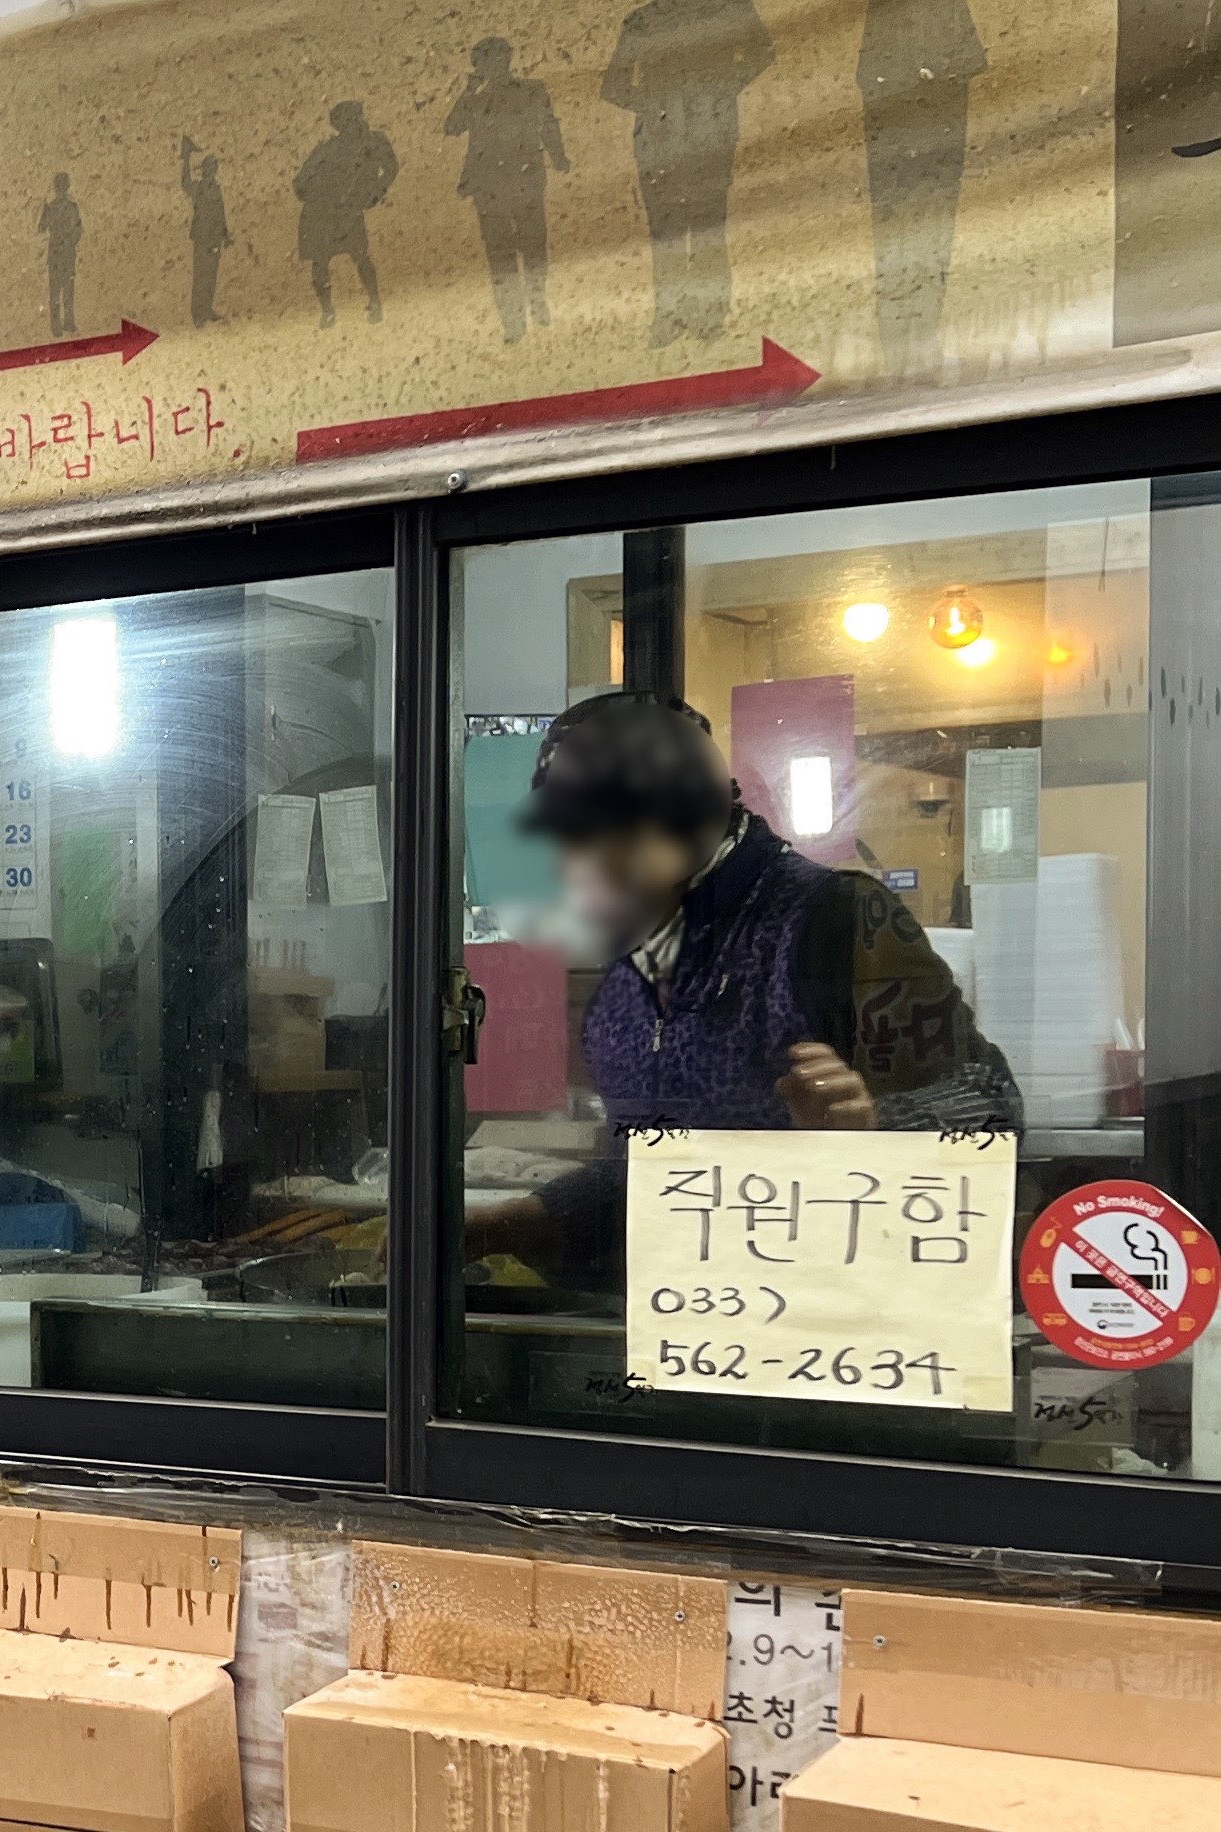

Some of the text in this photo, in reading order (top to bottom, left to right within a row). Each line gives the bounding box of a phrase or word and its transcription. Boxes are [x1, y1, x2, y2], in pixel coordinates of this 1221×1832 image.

[7, 780, 32, 801] 16
[5, 824, 32, 844] 23
[5, 866, 33, 888] 30
[659, 1165, 988, 1265] 직원구함
[1073, 1195, 1165, 1218] No Smoking!
[650, 1286, 787, 1325] 033)
[659, 1338, 957, 1396] 562-2634
